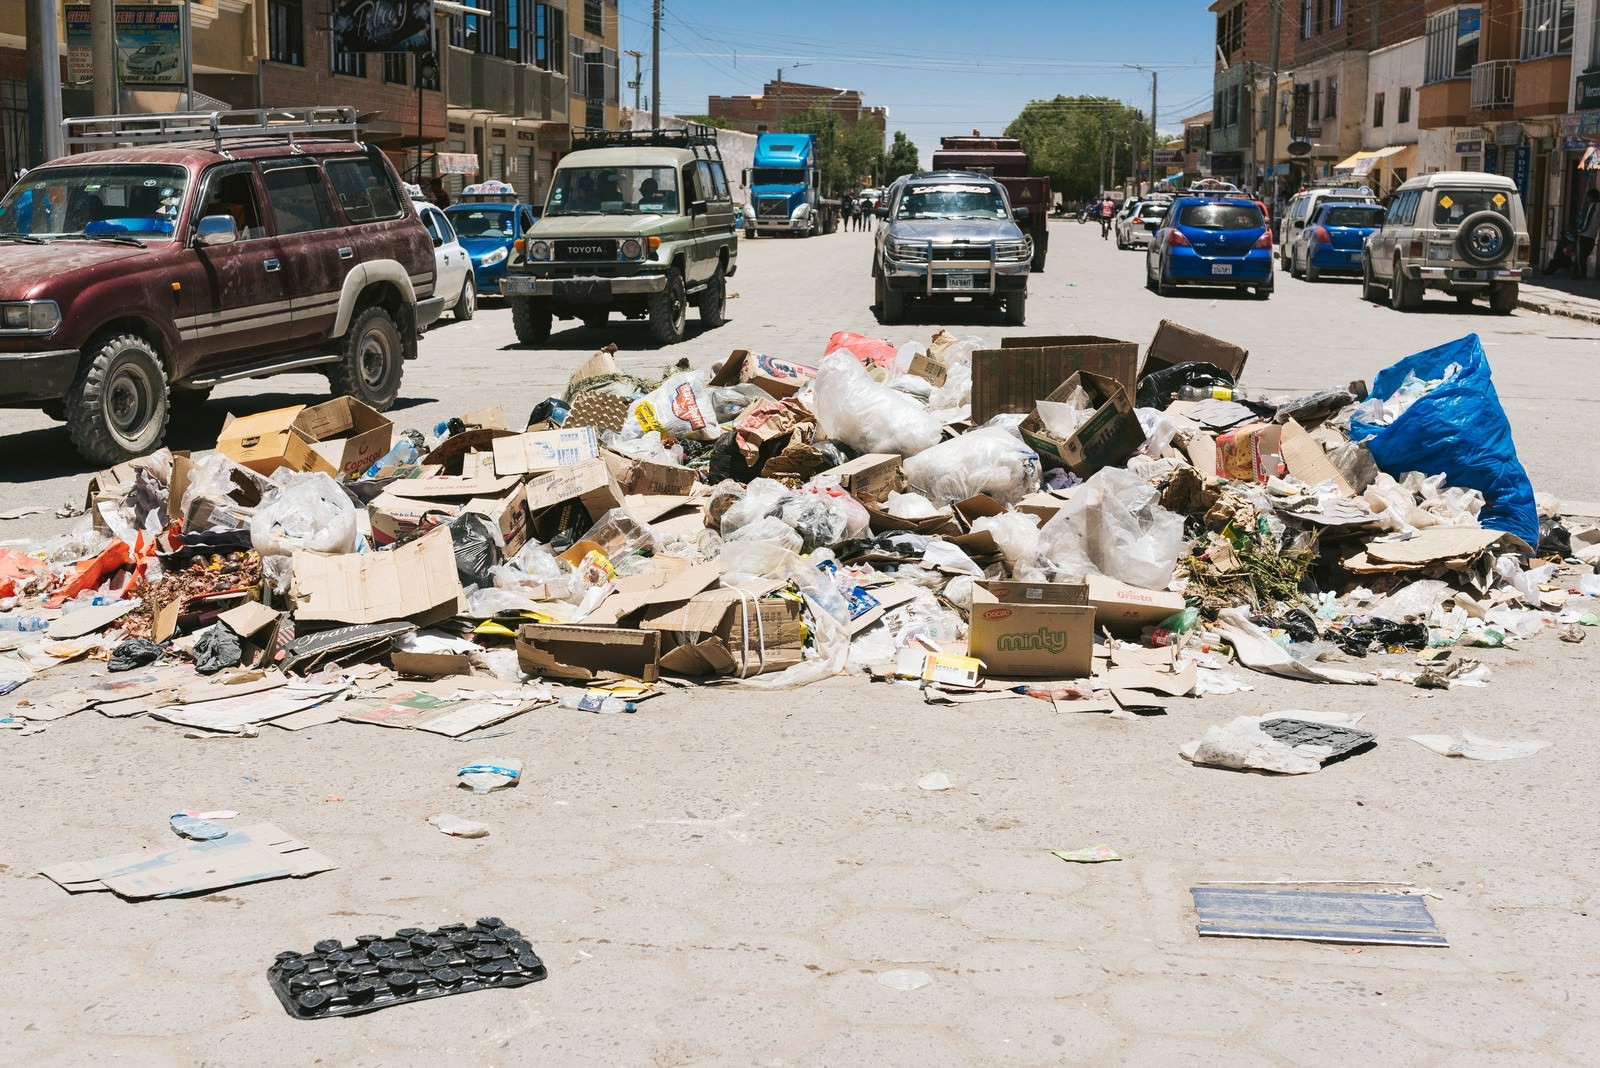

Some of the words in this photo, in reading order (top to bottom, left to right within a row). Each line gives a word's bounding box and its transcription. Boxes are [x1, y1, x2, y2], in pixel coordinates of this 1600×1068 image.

[568, 246, 603, 254] TOYOTA
[344, 448, 382, 472] Copacol
[997, 627, 1067, 654] minty
